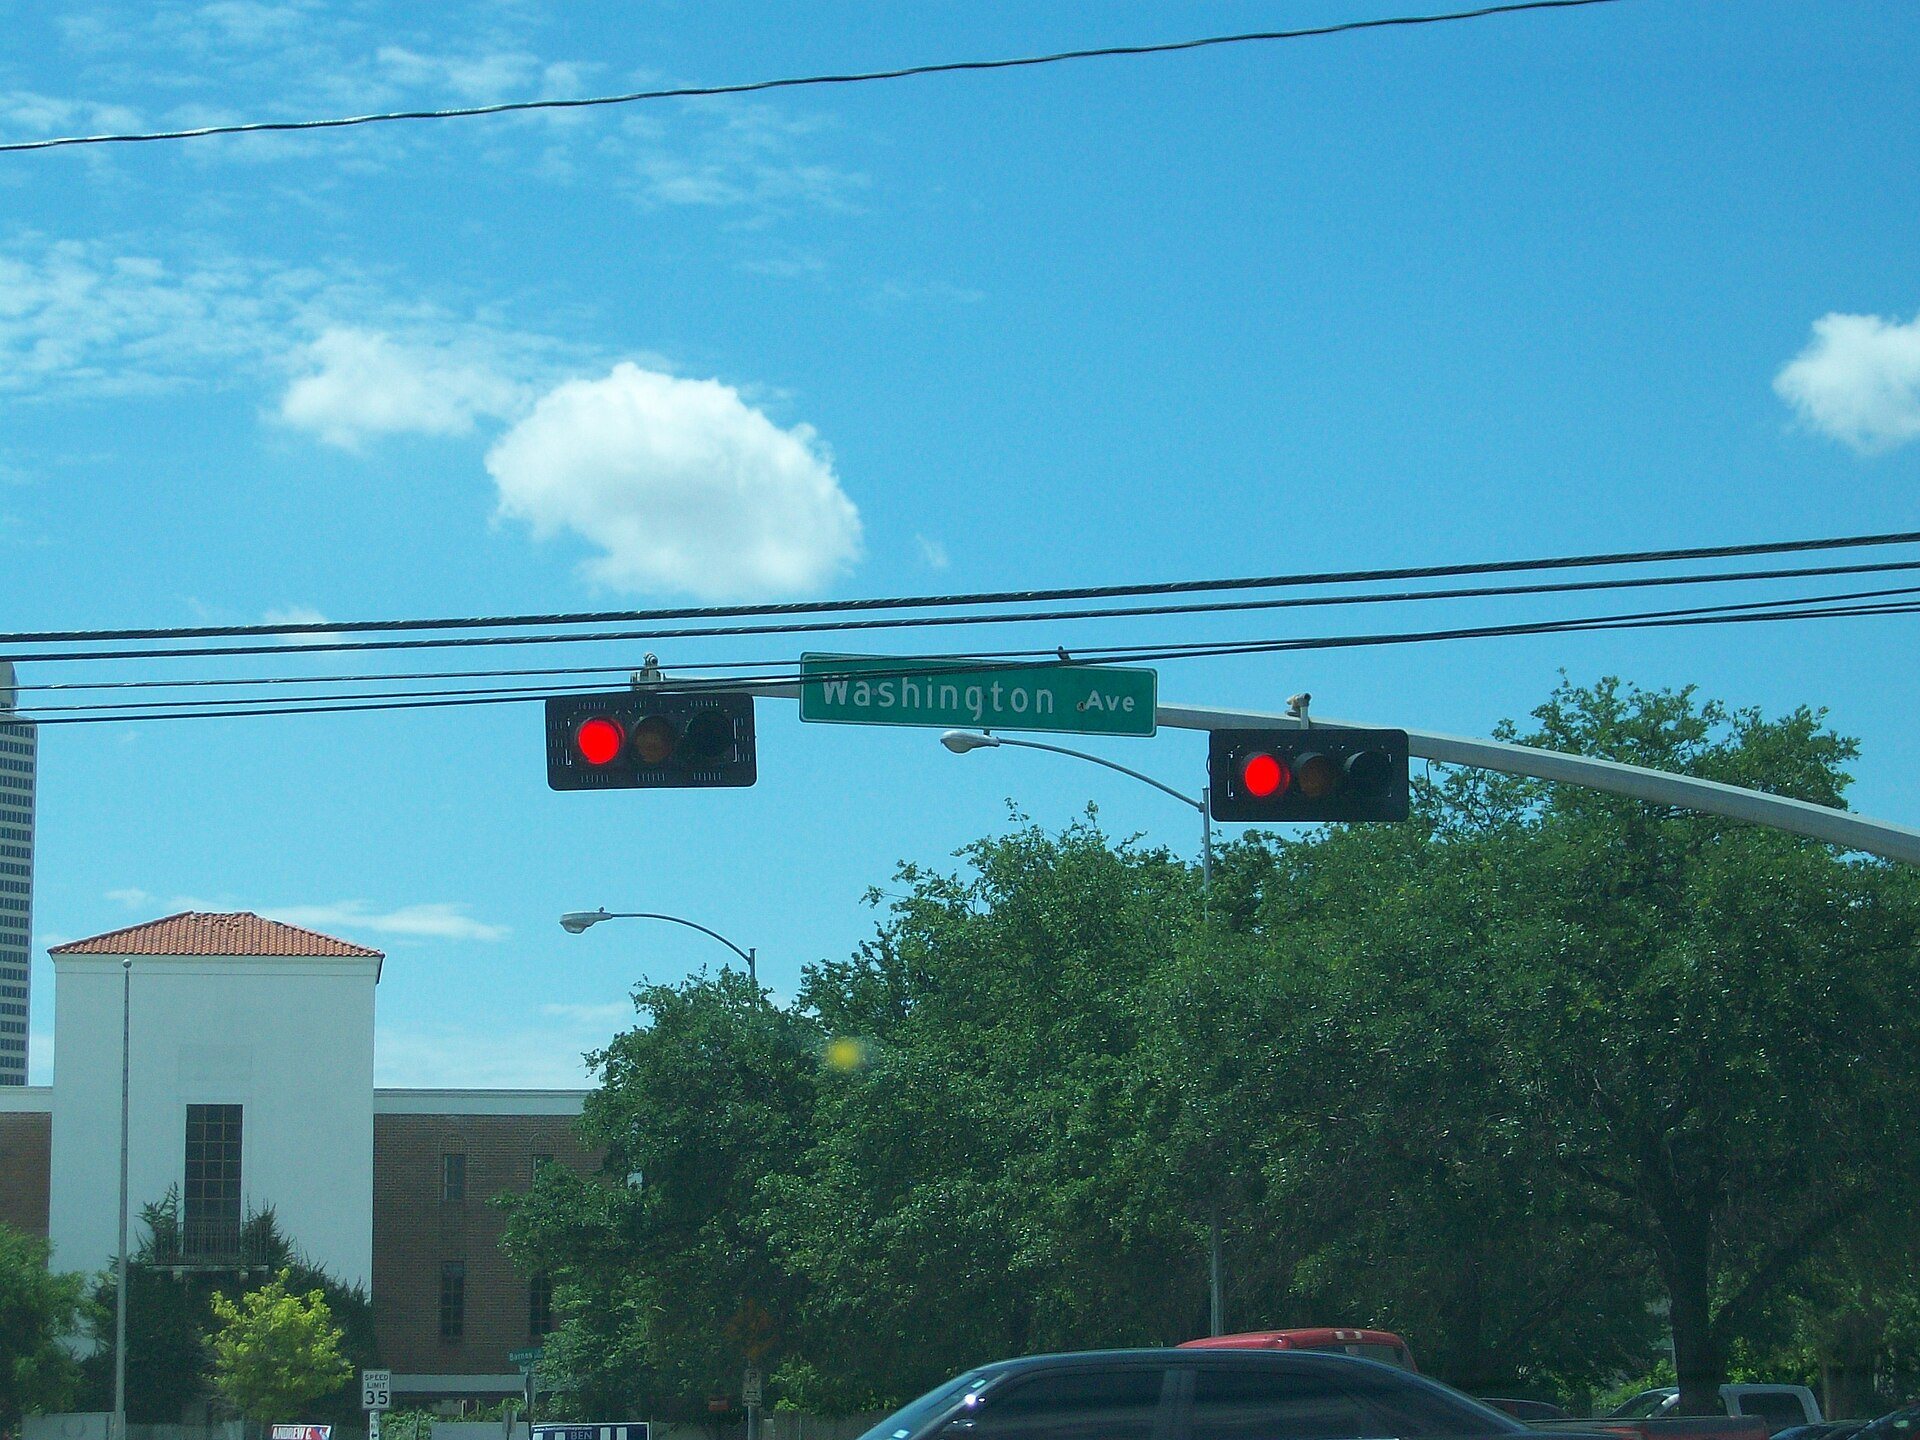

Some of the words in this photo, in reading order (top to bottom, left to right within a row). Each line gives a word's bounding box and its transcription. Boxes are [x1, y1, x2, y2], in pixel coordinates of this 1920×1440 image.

[822, 675, 1054, 722] Washington
[1084, 689, 1135, 713] Ave
[365, 1390, 388, 1405] 35
[272, 1427, 306, 1440] ANDREW
[571, 1431, 592, 1440] BEN
